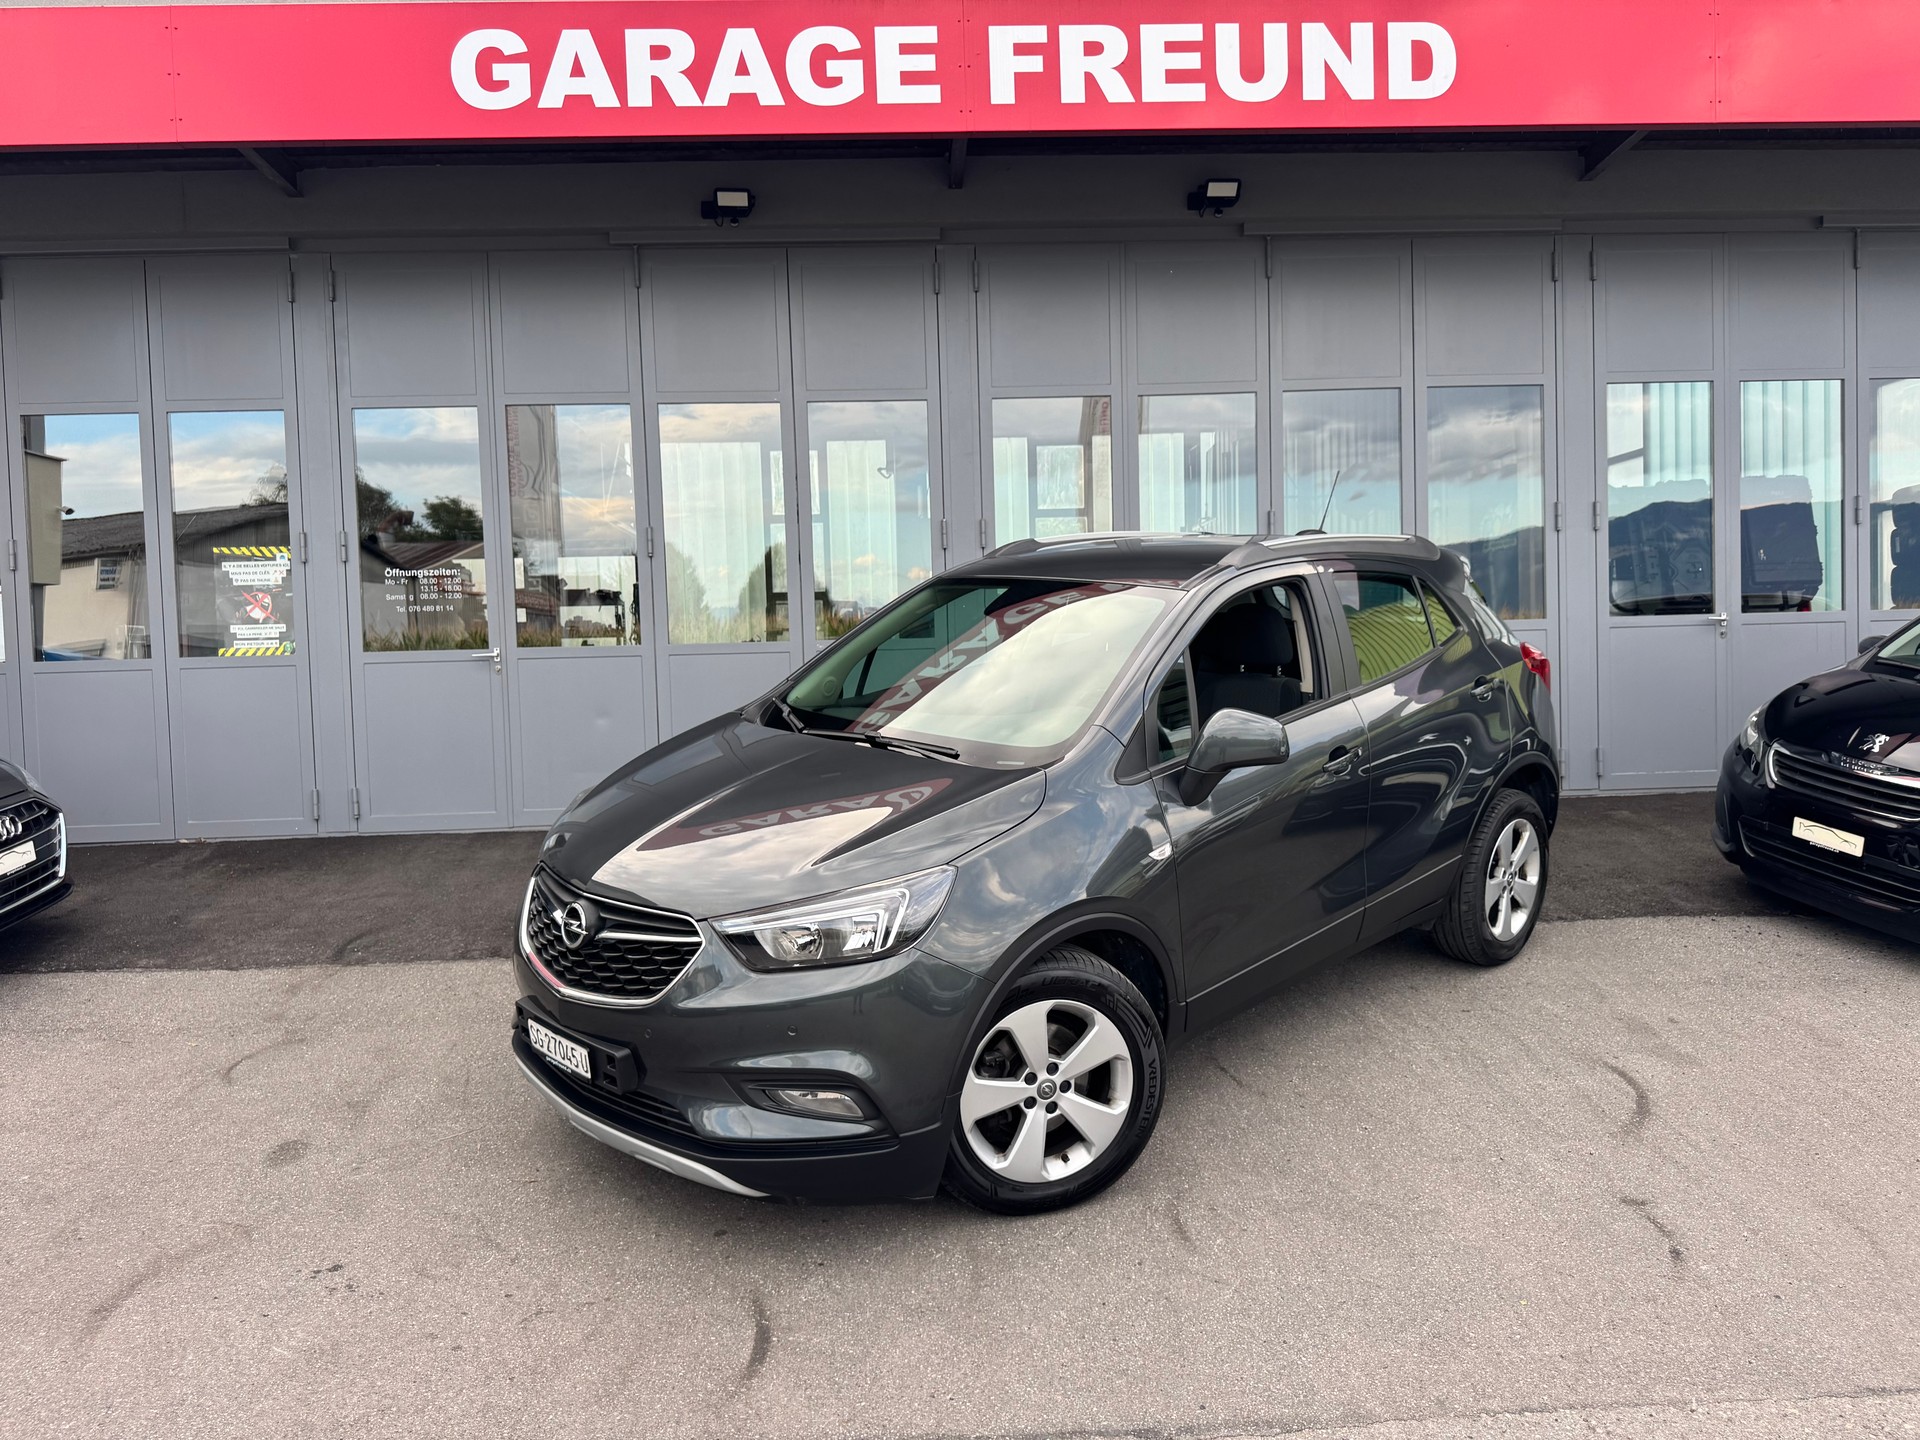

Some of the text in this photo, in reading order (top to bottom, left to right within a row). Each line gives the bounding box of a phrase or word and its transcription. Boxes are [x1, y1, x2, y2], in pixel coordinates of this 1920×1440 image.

[450, 21, 1458, 110] GARAGE FREUND
[384, 567, 460, 577] Öffnungszeiten:
[1136, 1057, 1158, 1140] VREDESTEIN
